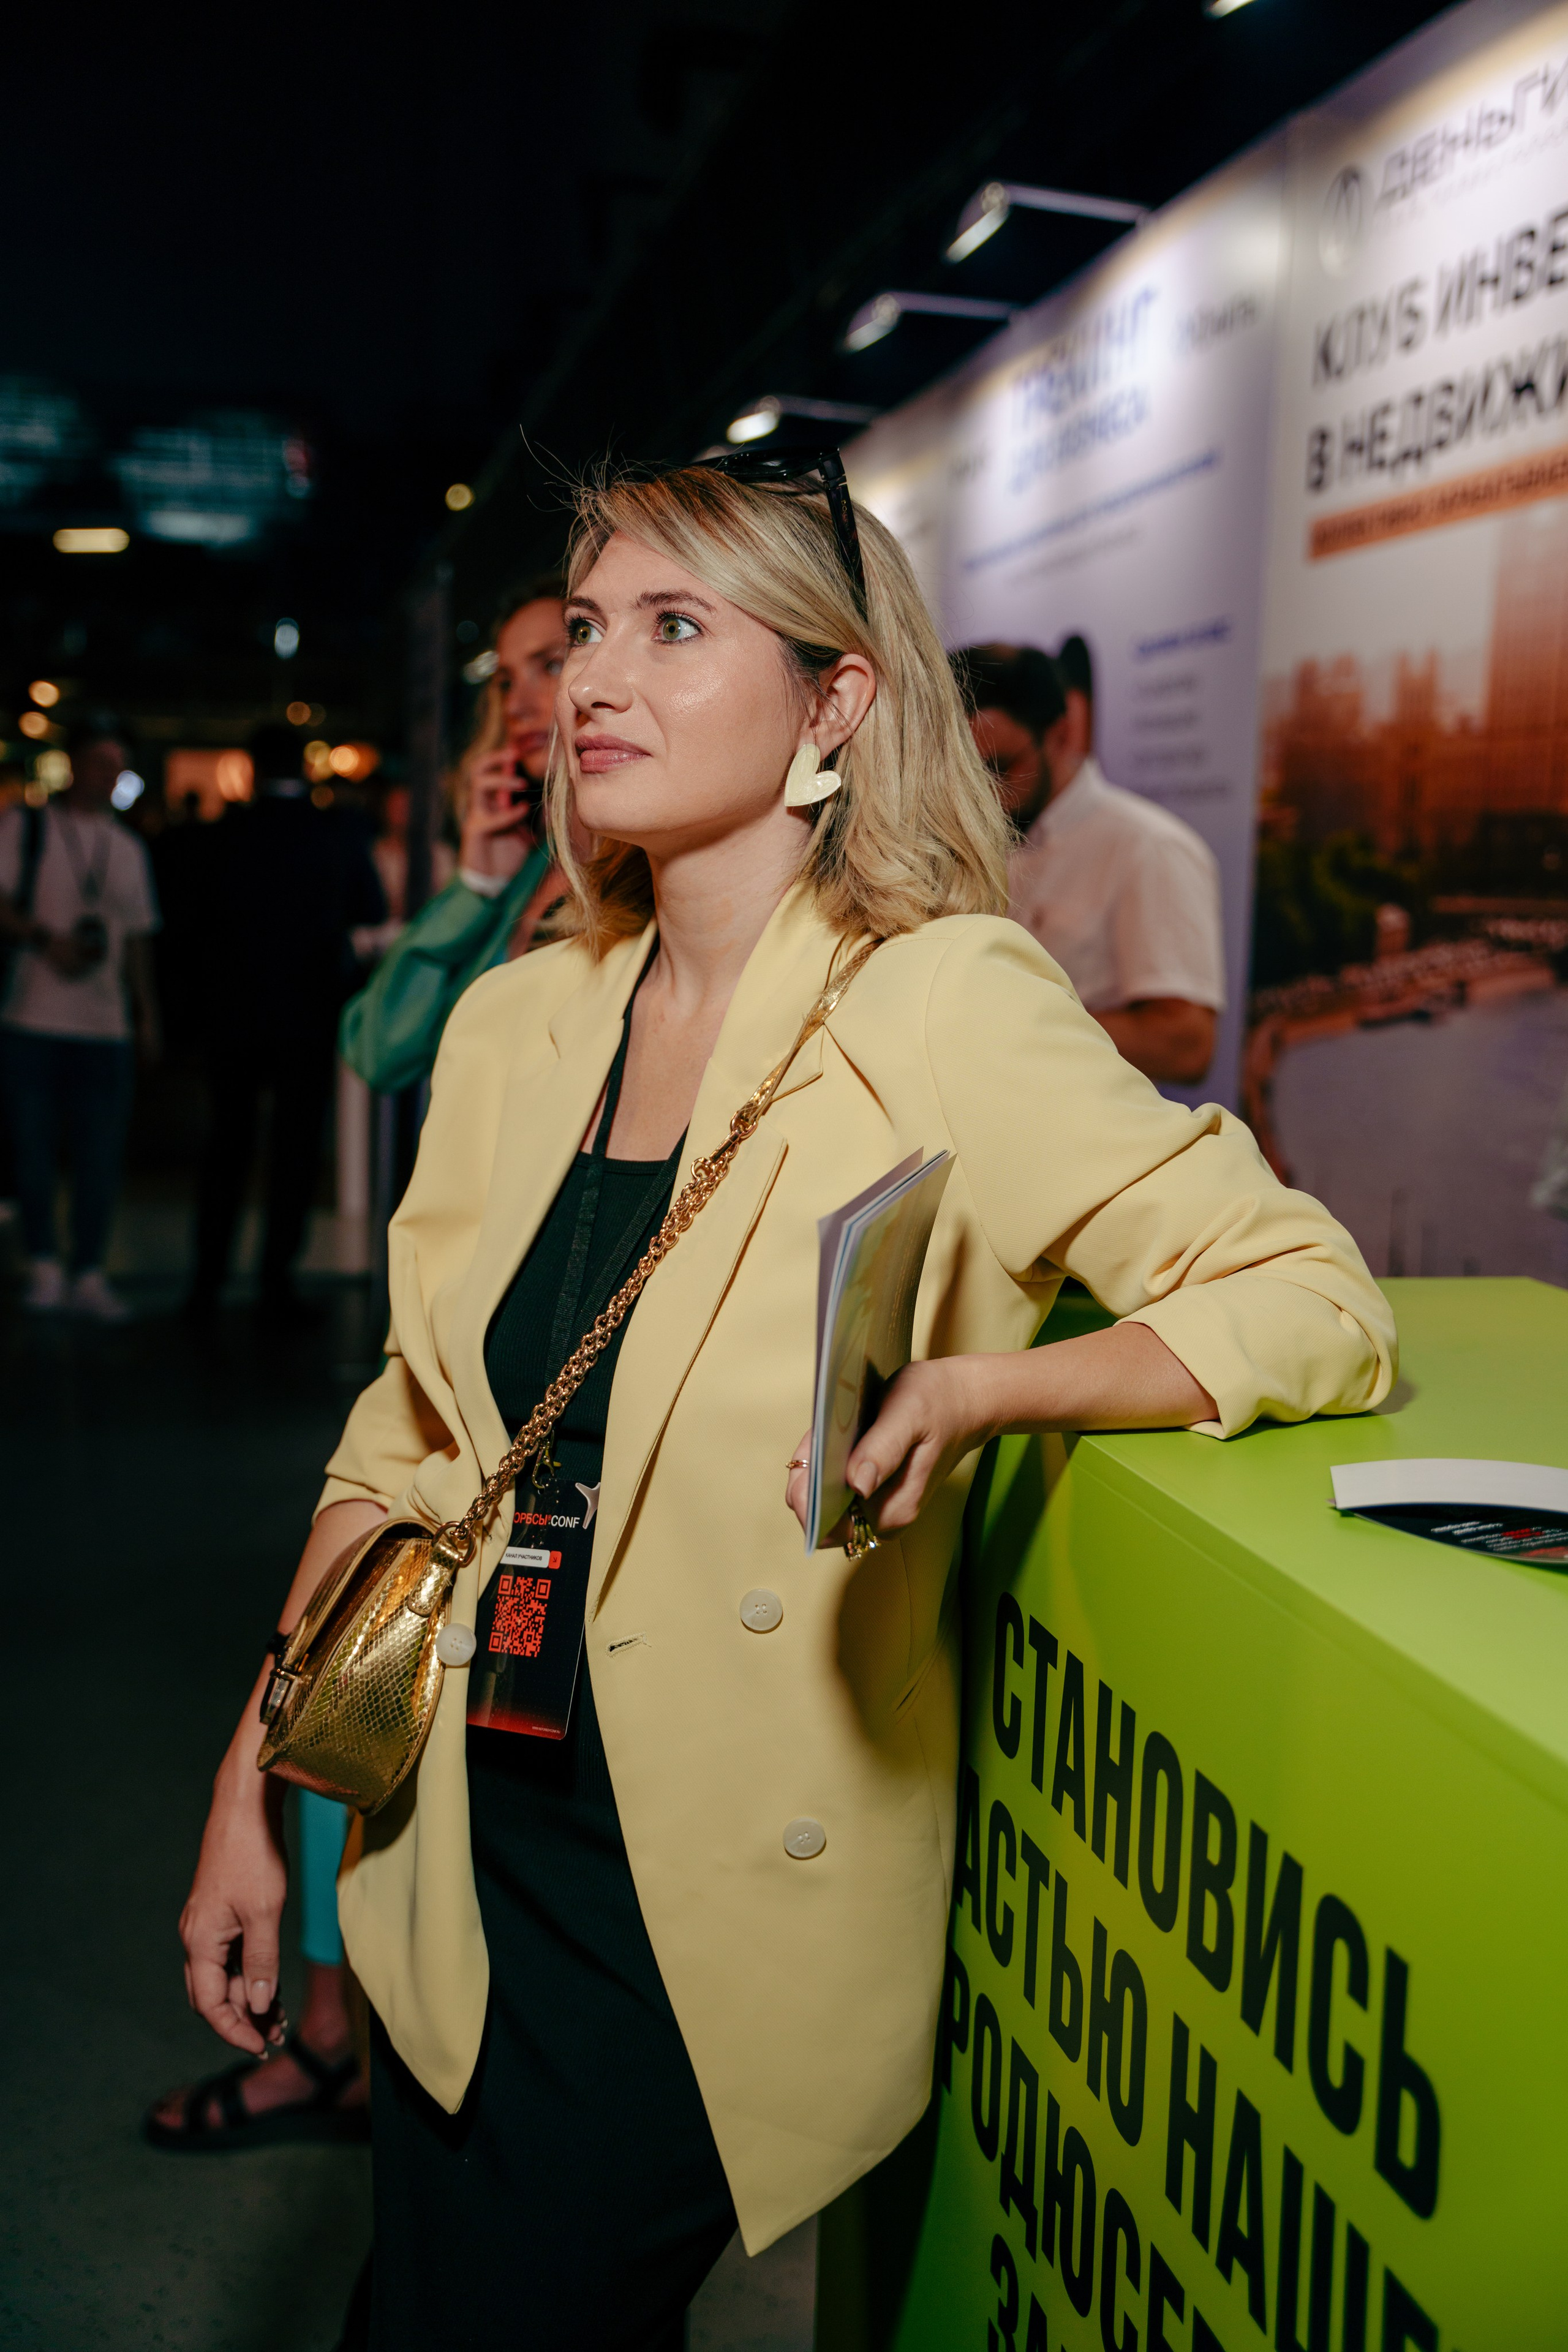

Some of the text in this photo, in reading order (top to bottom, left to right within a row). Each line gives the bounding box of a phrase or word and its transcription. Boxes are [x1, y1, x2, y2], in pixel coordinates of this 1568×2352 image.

[1313, 281, 1428, 387] КЛУБ
[1306, 425, 1334, 494] В
[993, 1593, 1441, 2220] СТАНОВИСЬ
